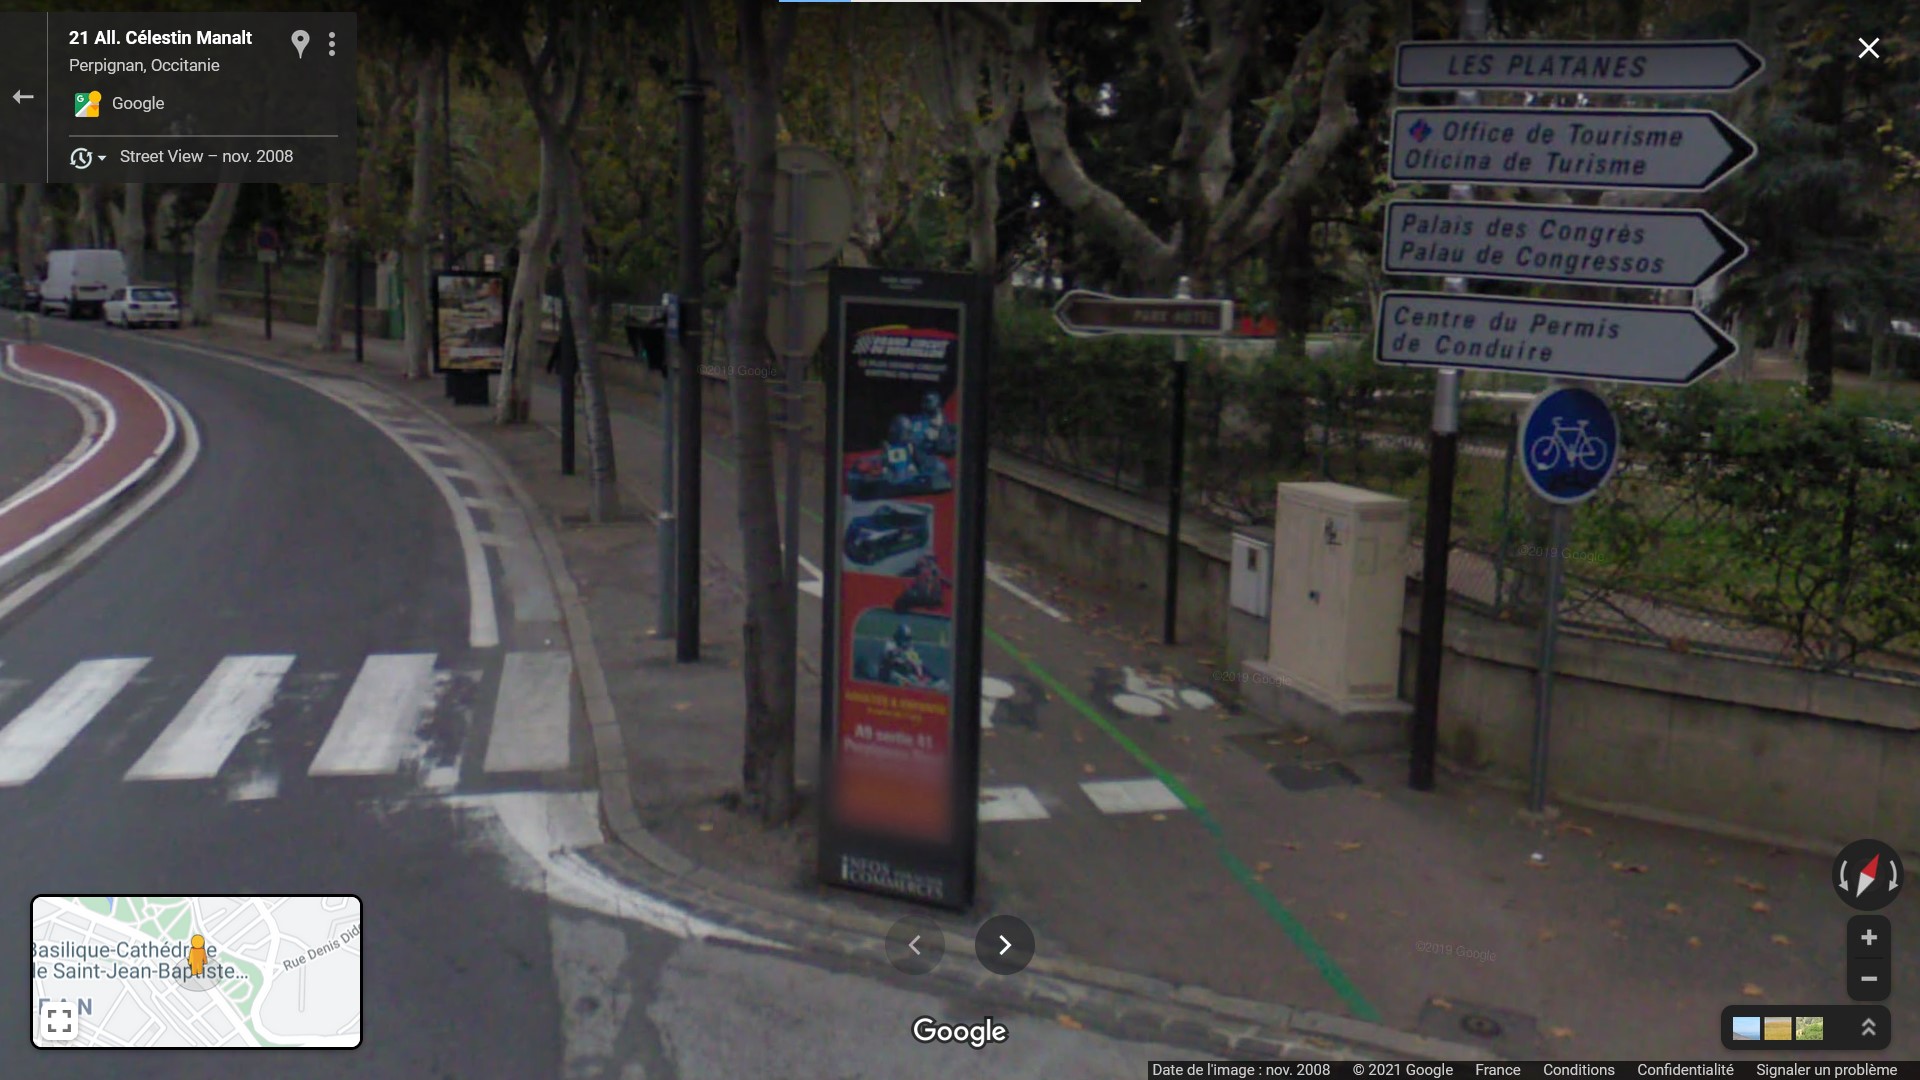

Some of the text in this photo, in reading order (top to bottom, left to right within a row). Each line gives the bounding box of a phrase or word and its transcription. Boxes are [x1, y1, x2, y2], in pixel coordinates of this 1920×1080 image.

[1448, 54, 1647, 79] LES PLATANES
[1443, 120, 1683, 148] Office de Tourisme
[1404, 149, 1647, 176] Oficina de Turisme
[1401, 213, 1645, 247] Palais des Congrès
[1400, 241, 1665, 275] Palau de Congressos
[1394, 306, 1620, 340] Centre du Permis
[1392, 334, 1553, 363] de Conduire
